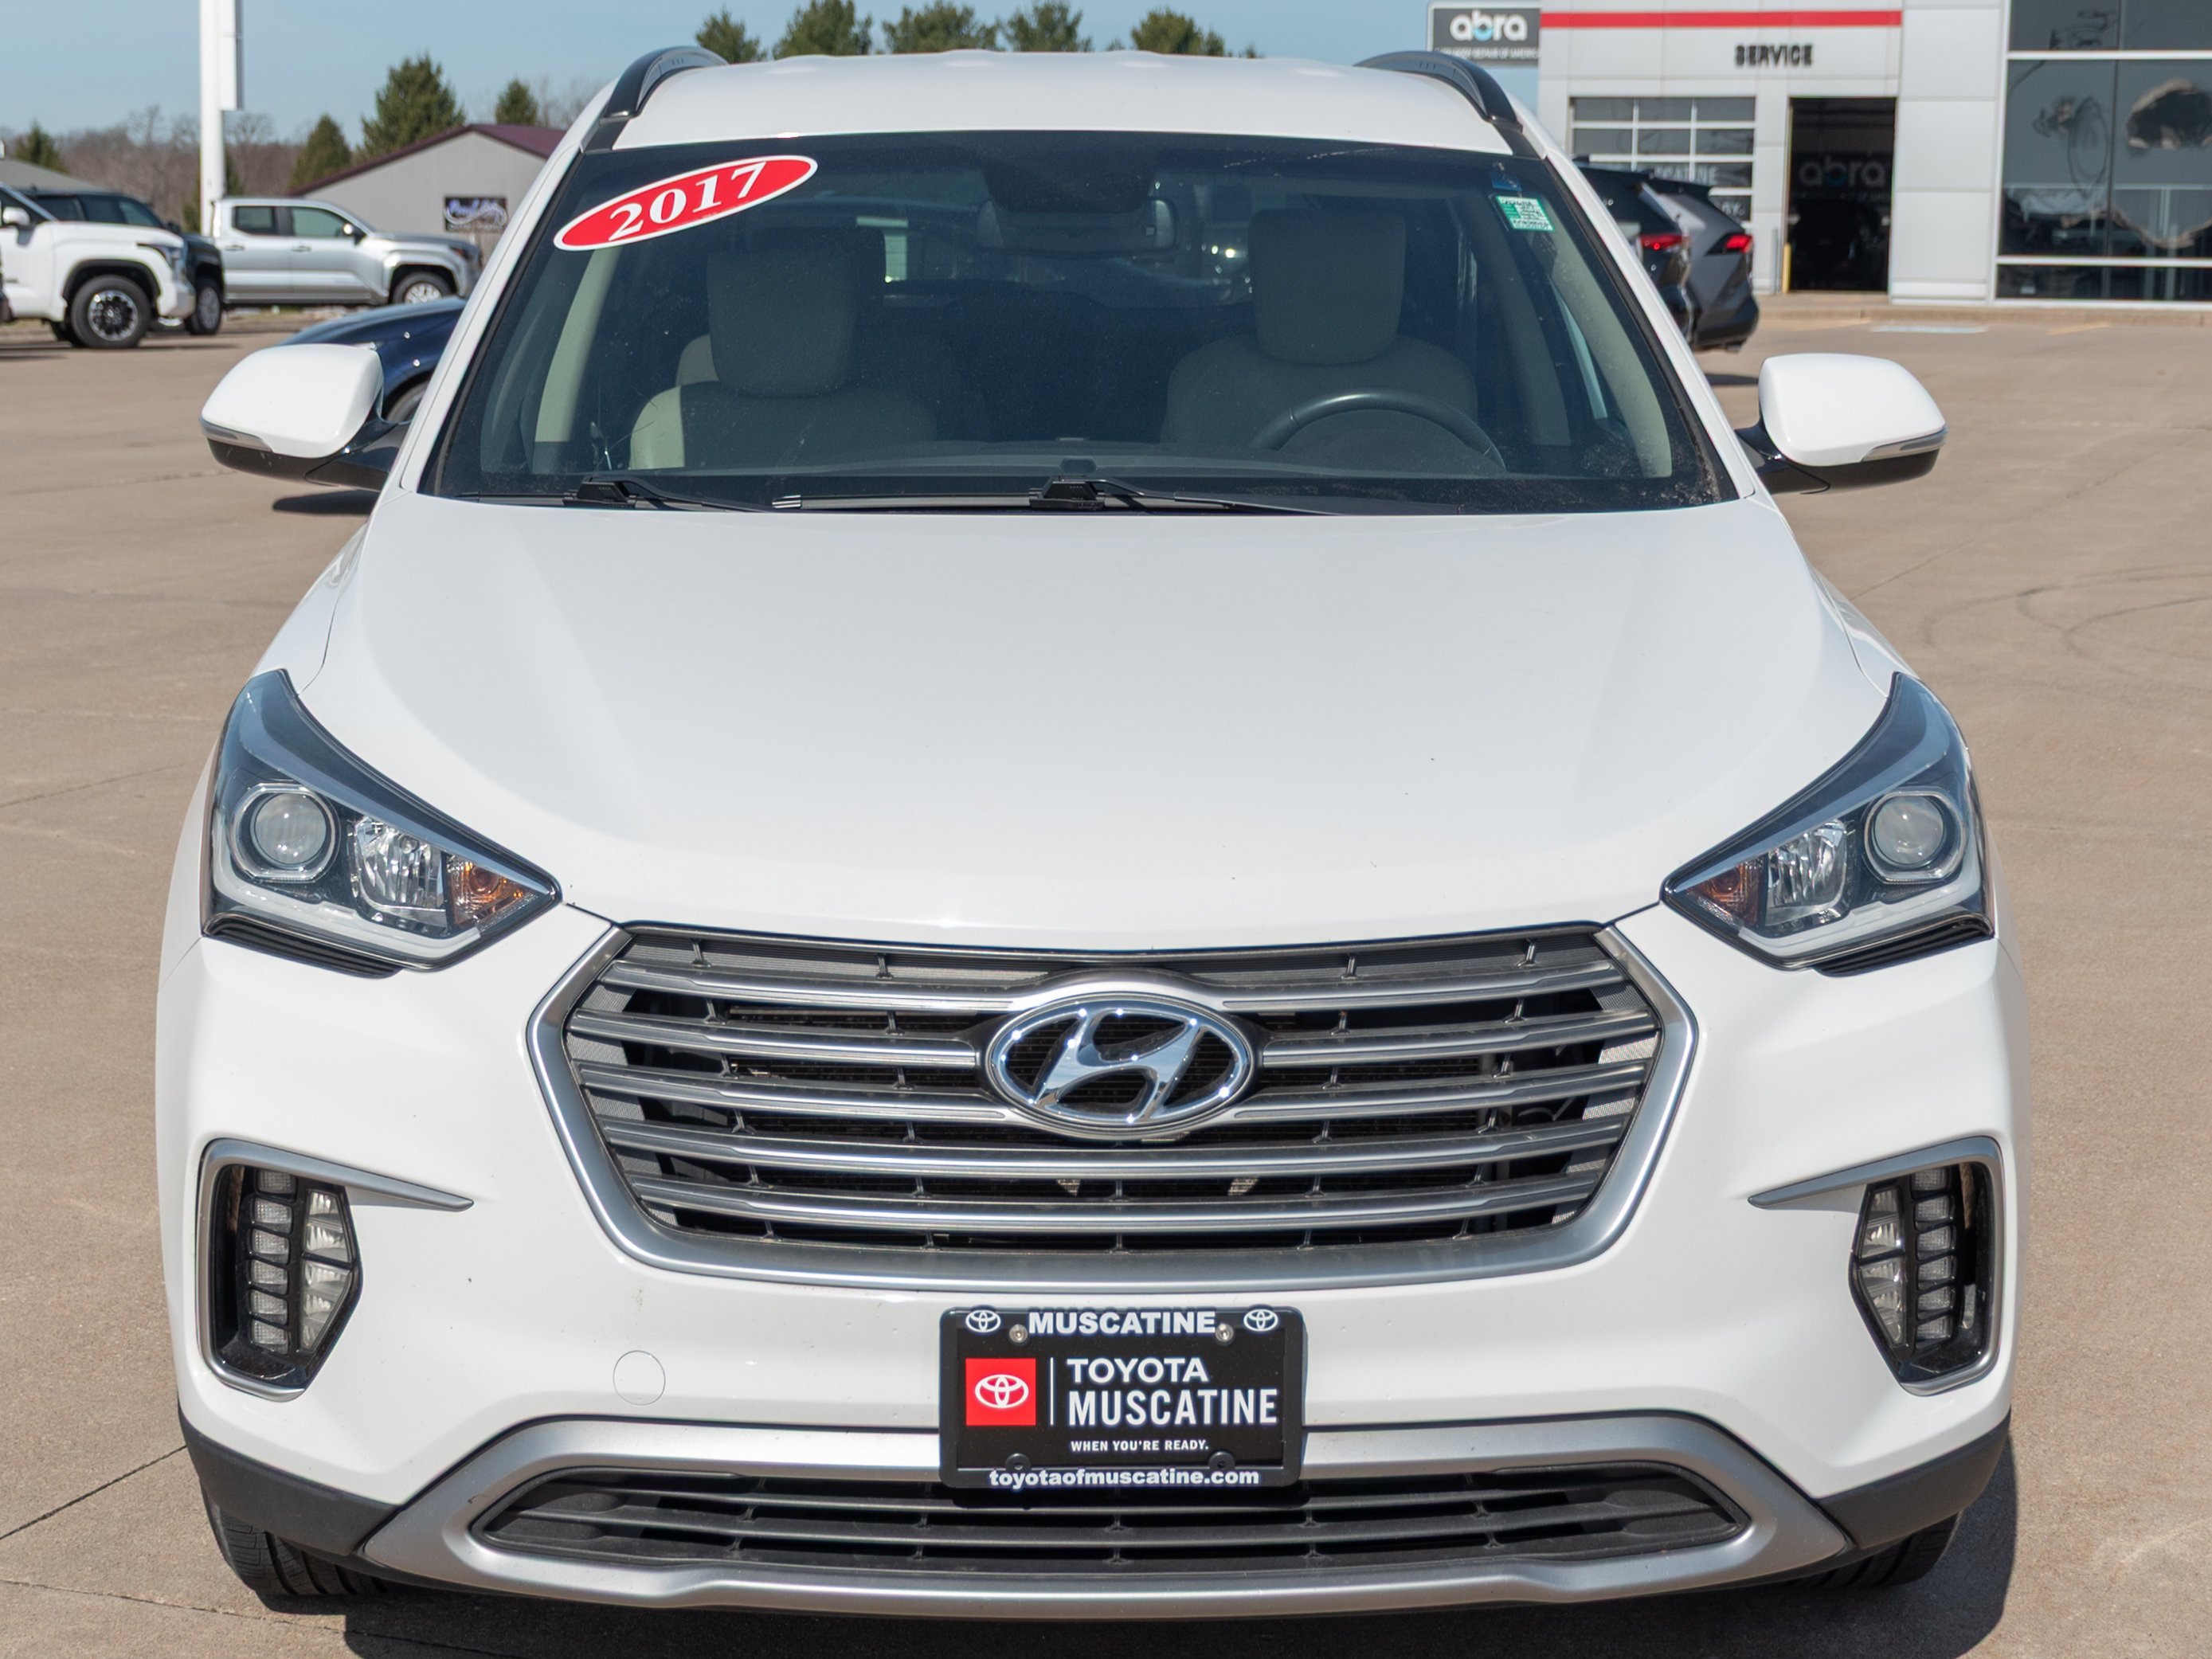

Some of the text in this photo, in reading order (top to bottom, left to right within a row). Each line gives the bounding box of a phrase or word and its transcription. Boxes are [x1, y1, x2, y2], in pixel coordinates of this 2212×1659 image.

[1450, 10, 1528, 41] abra
[1734, 44, 1814, 67] SERVICE
[1799, 155, 1885, 188] abra
[608, 161, 767, 242] 2017
[1028, 1311, 1216, 1335] MUSCATINE
[1066, 1357, 1209, 1383] TOYOTA
[1067, 1387, 1278, 1426] MUSCATINE
[1071, 1439, 1209, 1452] WHEN YOU'RE READY.
[989, 1468, 1260, 1489] toyotaofmuscatine.com
